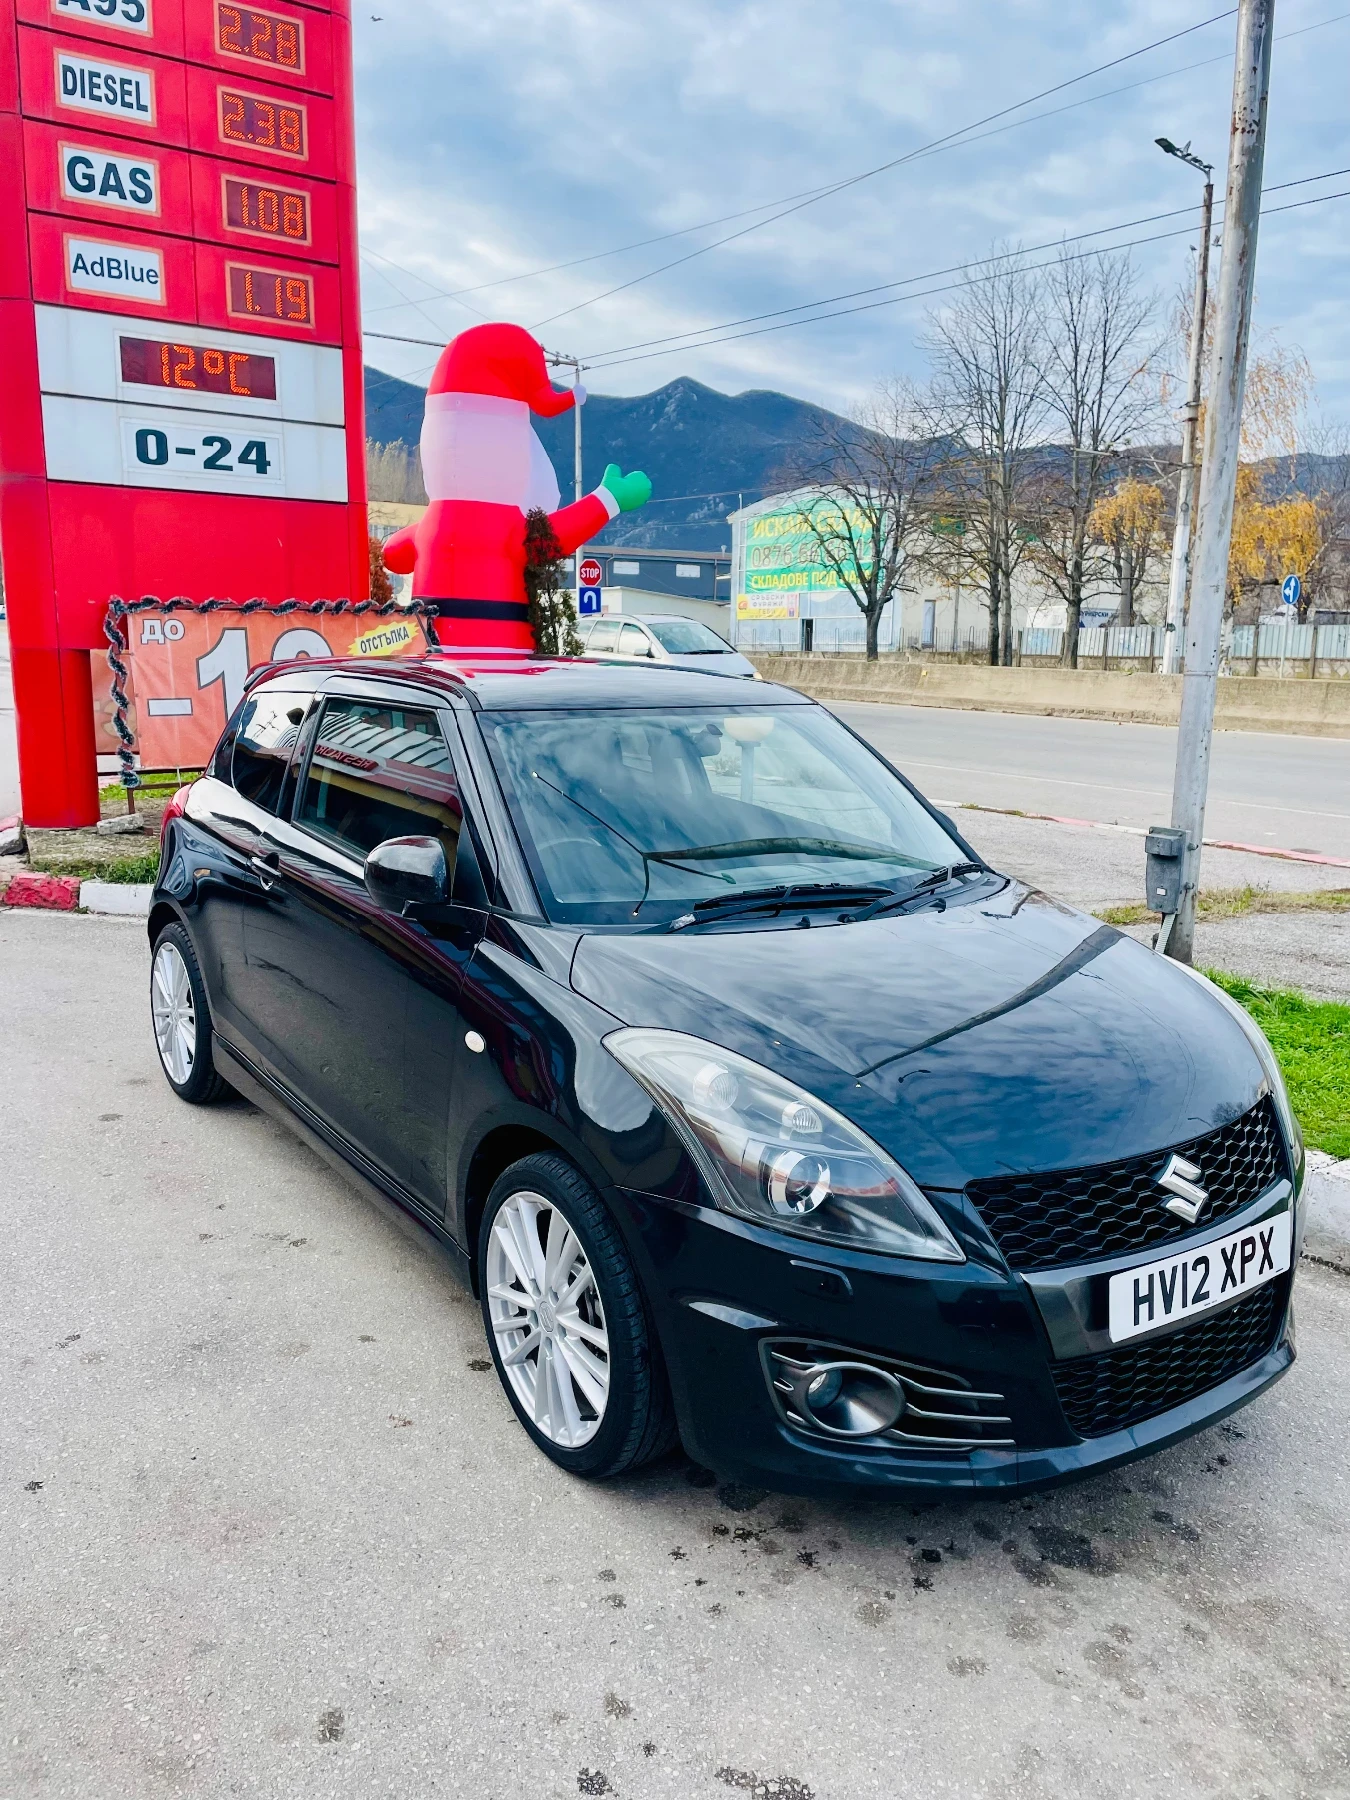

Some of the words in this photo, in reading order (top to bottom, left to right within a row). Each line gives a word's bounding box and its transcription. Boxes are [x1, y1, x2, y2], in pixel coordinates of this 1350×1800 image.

[220, 7, 297, 66] 2.28
[61, 64, 149, 113] DIESEL
[223, 94, 300, 152] 2.38
[66, 155, 153, 204] GAS
[240, 186, 304, 237] 1.08
[72, 252, 160, 285] AdBlue
[245, 271, 307, 320] 1.19
[135, 428, 271, 475] 0-24
[581, 567, 600, 578] STOP
[751, 542, 794, 568] 0876
[751, 571, 808, 590] СКЛАДОВЕ
[811, 570, 837, 587] ПОД
[360, 626, 410, 653] ОТСТЪПКА
[1133, 1255, 1210, 1326] HV12
[1220, 1226, 1274, 1293] XPX
